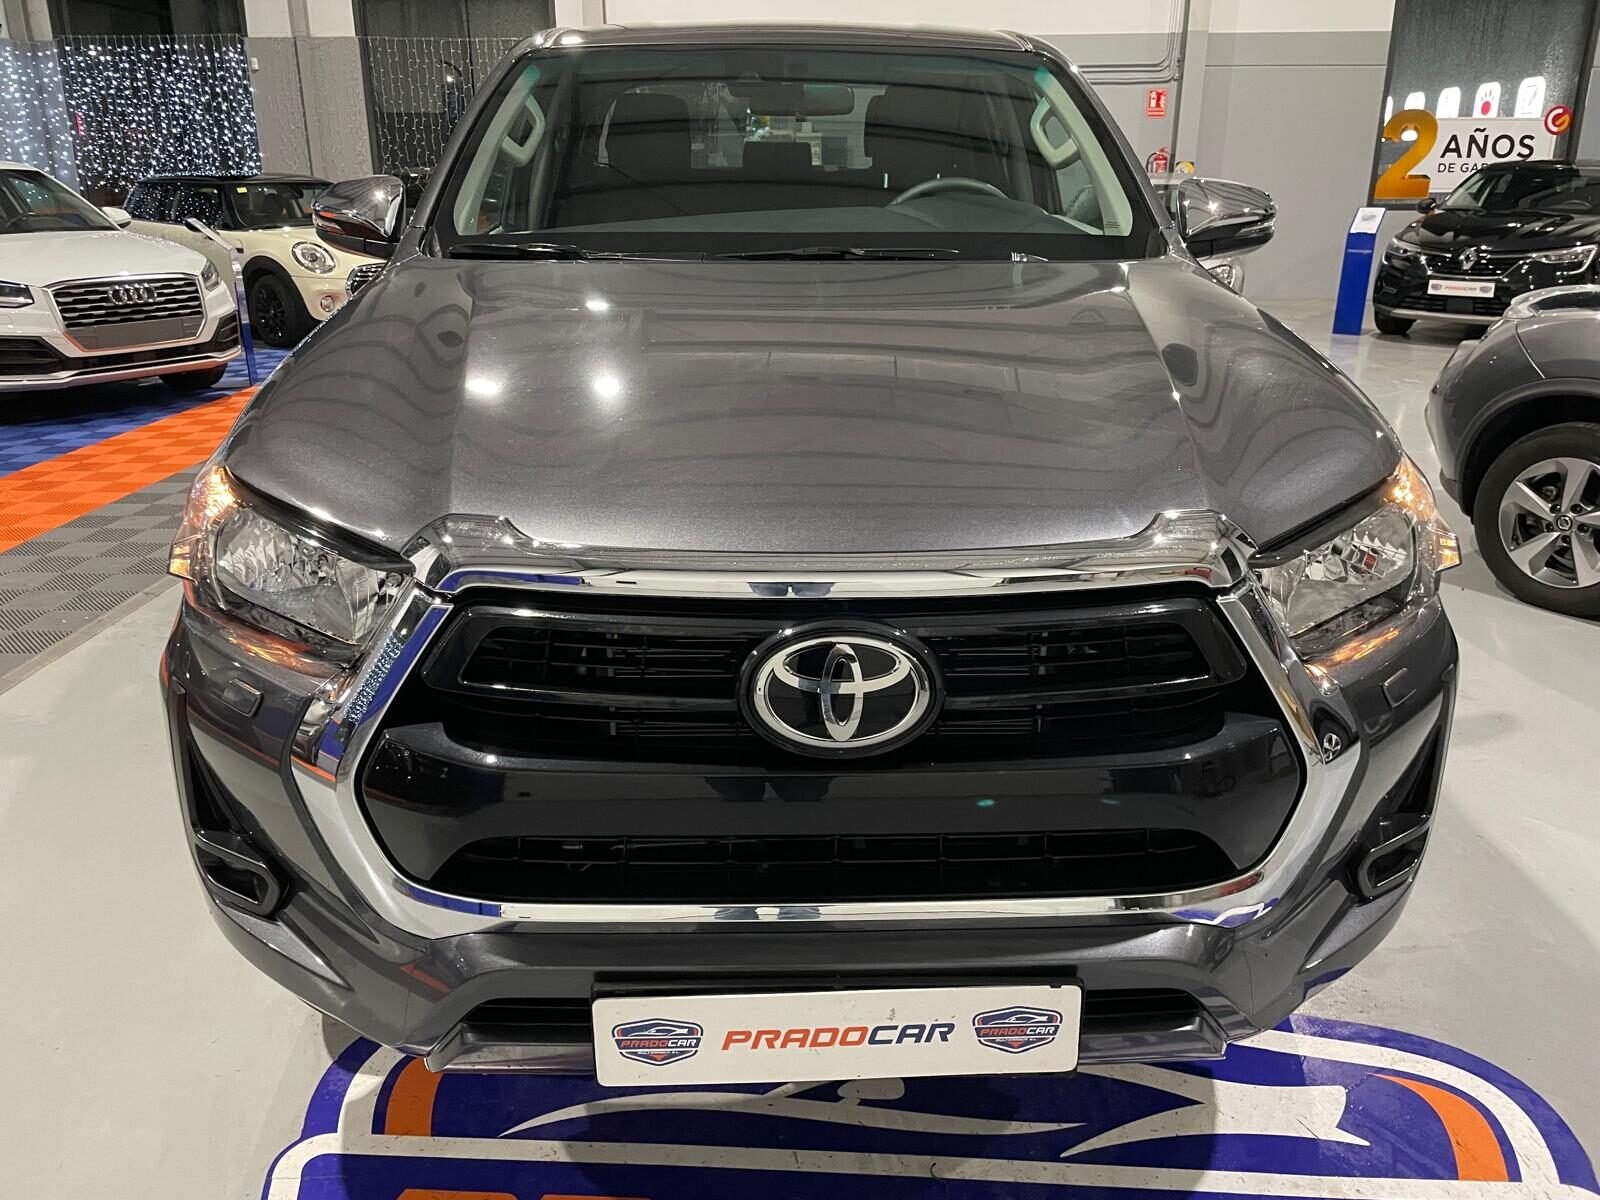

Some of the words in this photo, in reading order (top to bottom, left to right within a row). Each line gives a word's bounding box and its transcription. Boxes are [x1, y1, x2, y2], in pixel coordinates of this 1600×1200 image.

[1375, 108, 1438, 199] 2
[1440, 127, 1536, 159] AÑOS
[1437, 162, 1456, 173] DE
[721, 1022, 956, 1051] PRADOCAR
[979, 1026, 1055, 1036] PRADOCAR
[621, 1039, 697, 1048] PRADOCAR
